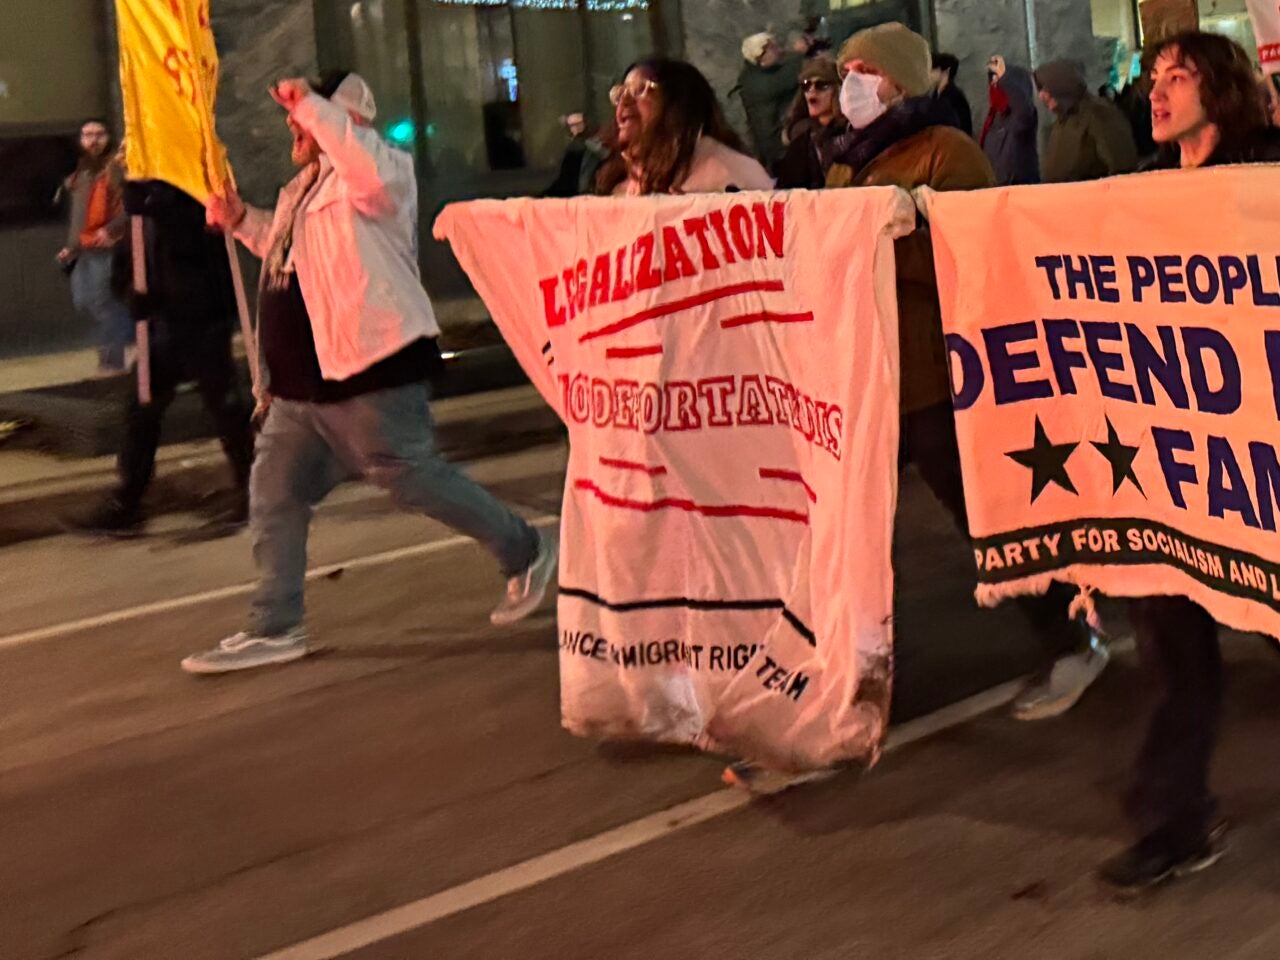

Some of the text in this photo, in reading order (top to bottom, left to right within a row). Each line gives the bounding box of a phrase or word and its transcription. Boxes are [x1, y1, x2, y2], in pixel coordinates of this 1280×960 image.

[539, 201, 786, 328] LEGALIZATION
[1035, 255, 1120, 303] THE
[947, 318, 1242, 415] DEFEND
[974, 533, 1062, 571] PARTY
[1071, 527, 1121, 553] FOR
[1126, 527, 1225, 579] SOCIALISM
[1230, 560, 1268, 593] AND
